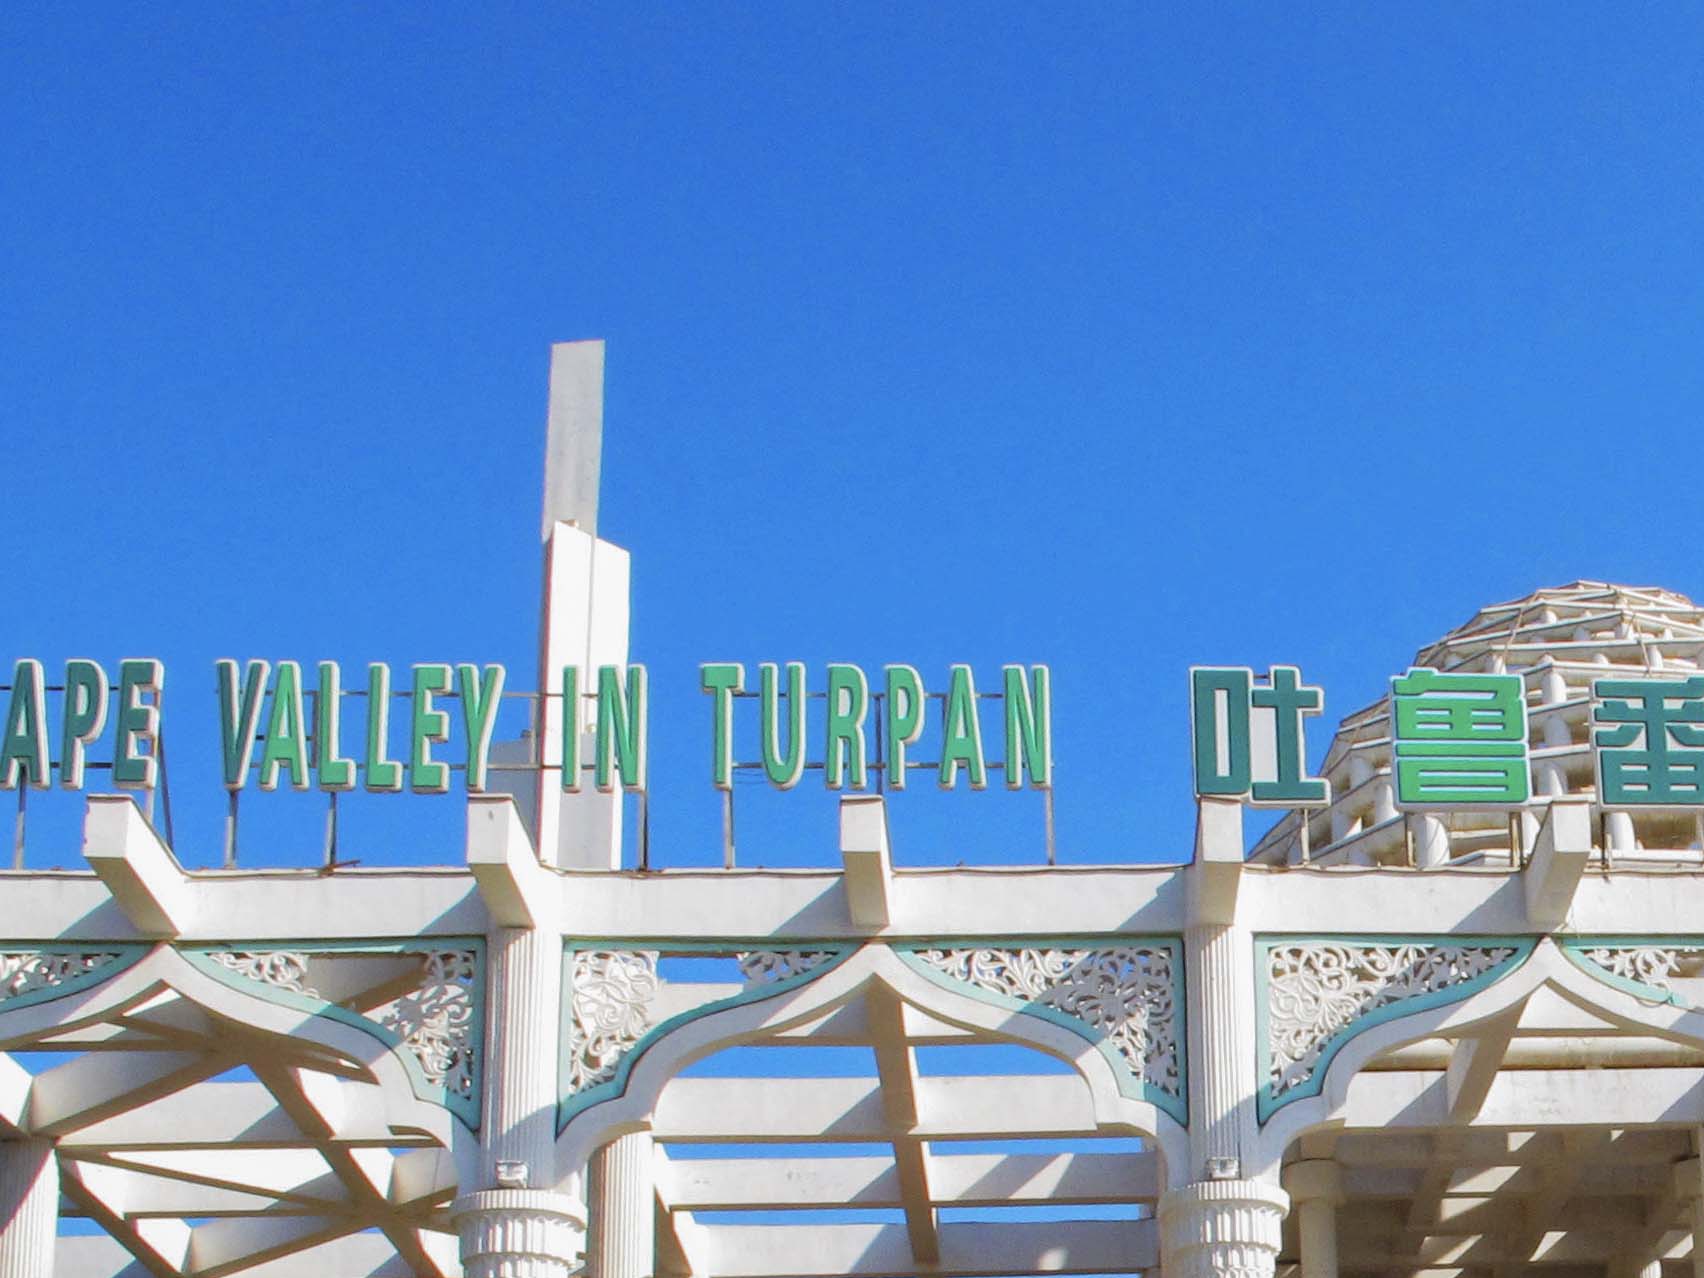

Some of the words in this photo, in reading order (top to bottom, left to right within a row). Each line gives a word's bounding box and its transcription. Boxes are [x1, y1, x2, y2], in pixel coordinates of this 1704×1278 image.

[0, 658, 164, 790] APE
[216, 659, 505, 794] VALLEY
[562, 663, 647, 794] IN
[700, 661, 1052, 792] TURPAN
